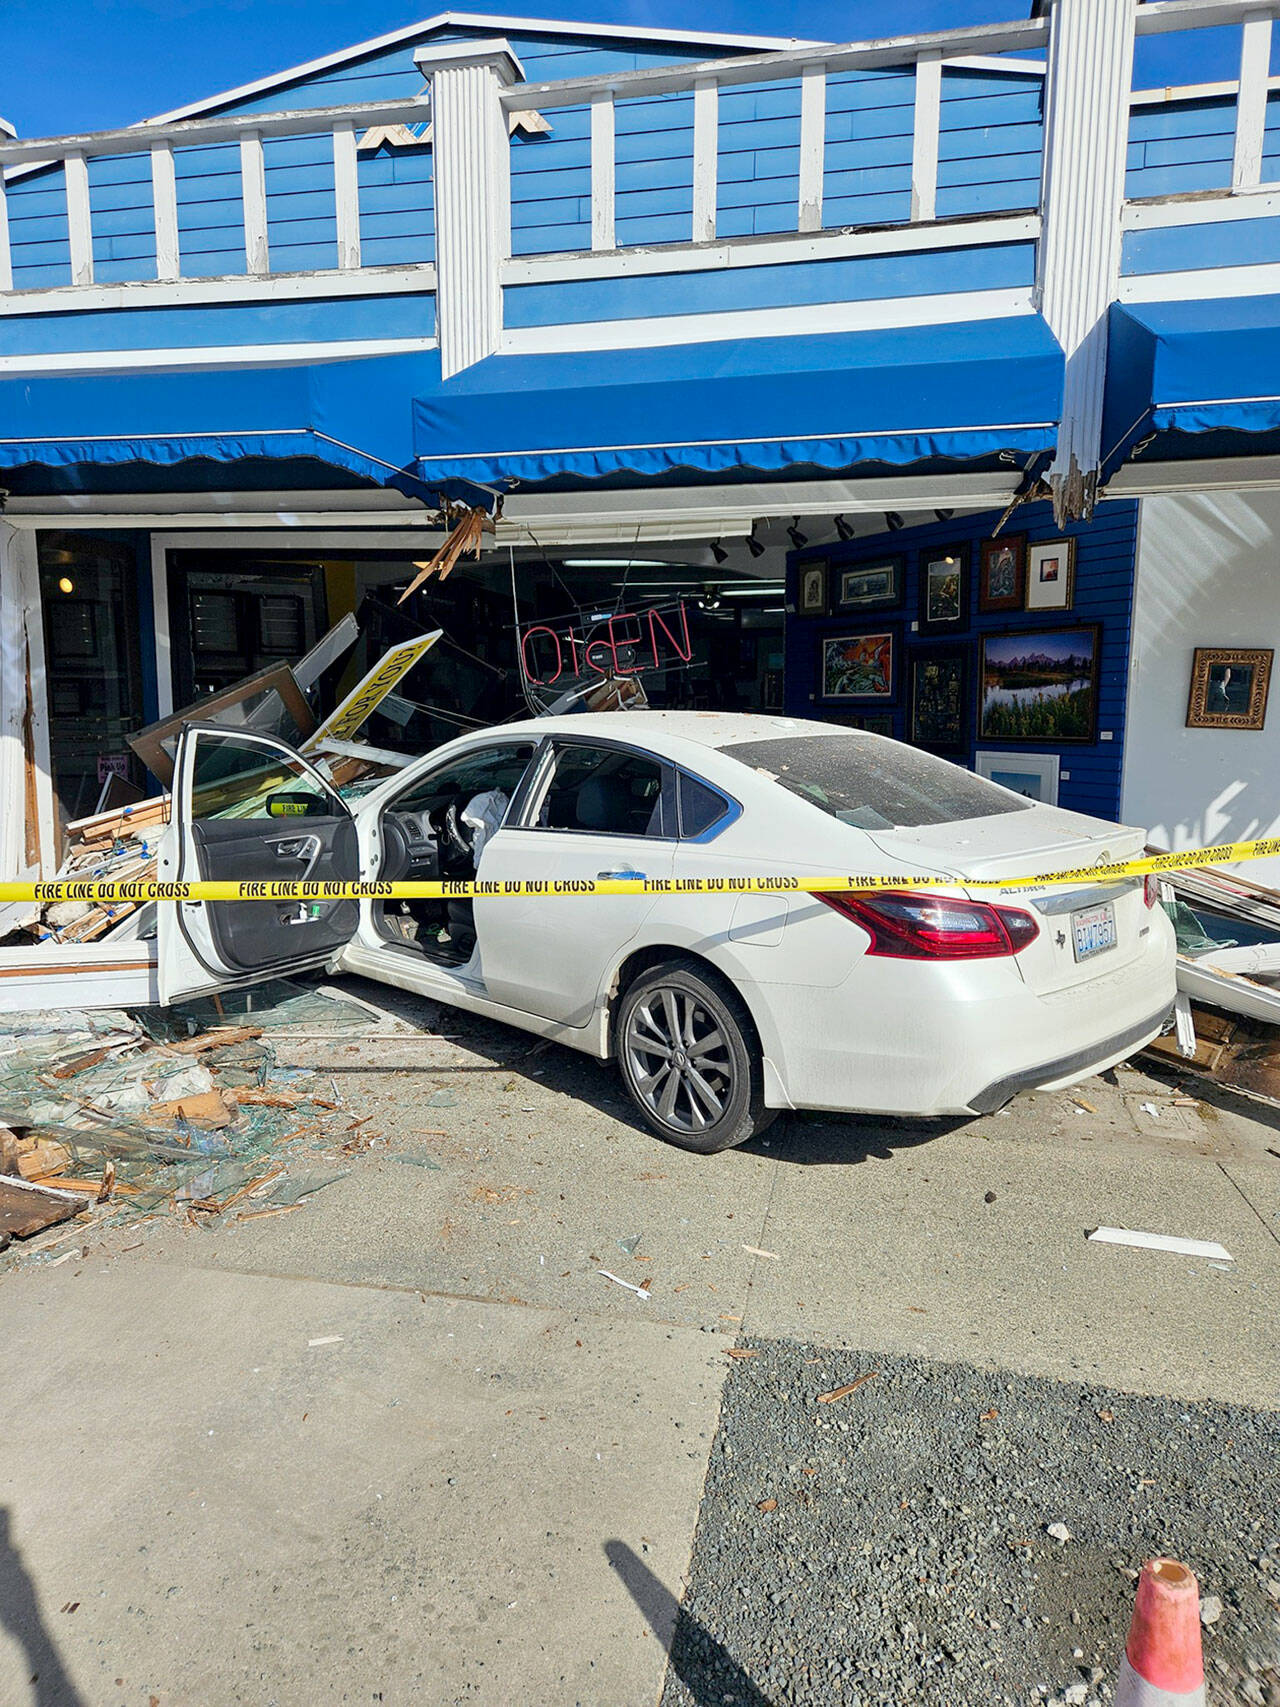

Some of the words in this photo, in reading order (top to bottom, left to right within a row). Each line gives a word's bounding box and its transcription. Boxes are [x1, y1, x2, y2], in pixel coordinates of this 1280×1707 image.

[334, 690, 383, 726] FOR
[365, 645, 423, 693] YOU?
[34, 884, 63, 899] FIRE
[66, 883, 95, 898] LINE
[98, 883, 115, 898] DO
[119, 883, 147, 897] NOT
[147, 882, 190, 897] CROSS
[239, 882, 267, 897] FIRE
[271, 882, 298, 896] LINE
[303, 882, 319, 896] DO
[323, 882, 347, 895] NOT
[352, 882, 393, 895] CROSS
[442, 881, 469, 894] FIRE
[474, 881, 500, 894] LINE
[505, 881, 521, 893] DO
[526, 881, 548, 893] NOT
[554, 880, 595, 892] CROSS
[644, 880, 671, 891] FIRE
[676, 879, 703, 891] LINE
[707, 878, 724, 890] DO
[729, 878, 752, 889] NOT
